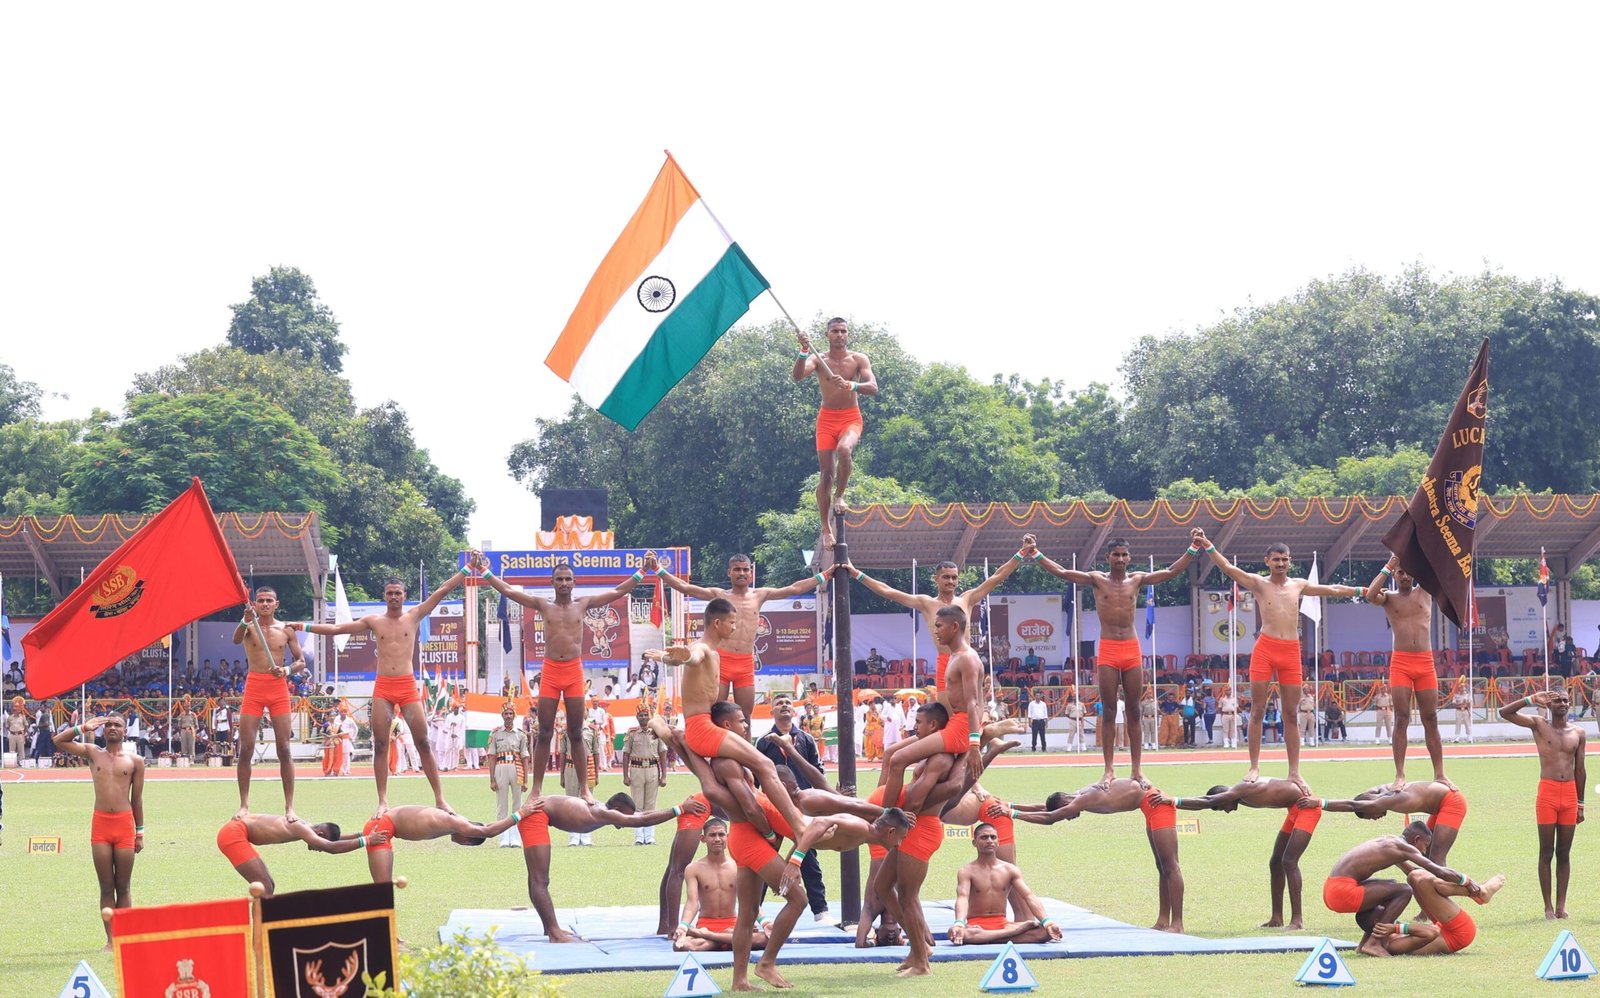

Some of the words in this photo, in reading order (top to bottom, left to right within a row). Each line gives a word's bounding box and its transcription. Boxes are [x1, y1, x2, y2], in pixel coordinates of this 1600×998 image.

[1435, 514, 1462, 557] Seema
[501, 553, 569, 570] Sashastra
[573, 552, 621, 568] Seema
[102, 574, 125, 598] SSB
[440, 622, 458, 634] 73RD
[1021, 623, 1050, 636] राजेश
[418, 651, 459, 664] CLUSTER
[946, 826, 970, 837] केरल
[32, 840, 57, 852] कर्नाटक
[1002, 957, 1019, 984] 8
[1318, 952, 1338, 979] 9
[1560, 948, 1581, 973] 10
[72, 975, 91, 998] 5
[682, 967, 699, 991] 7
